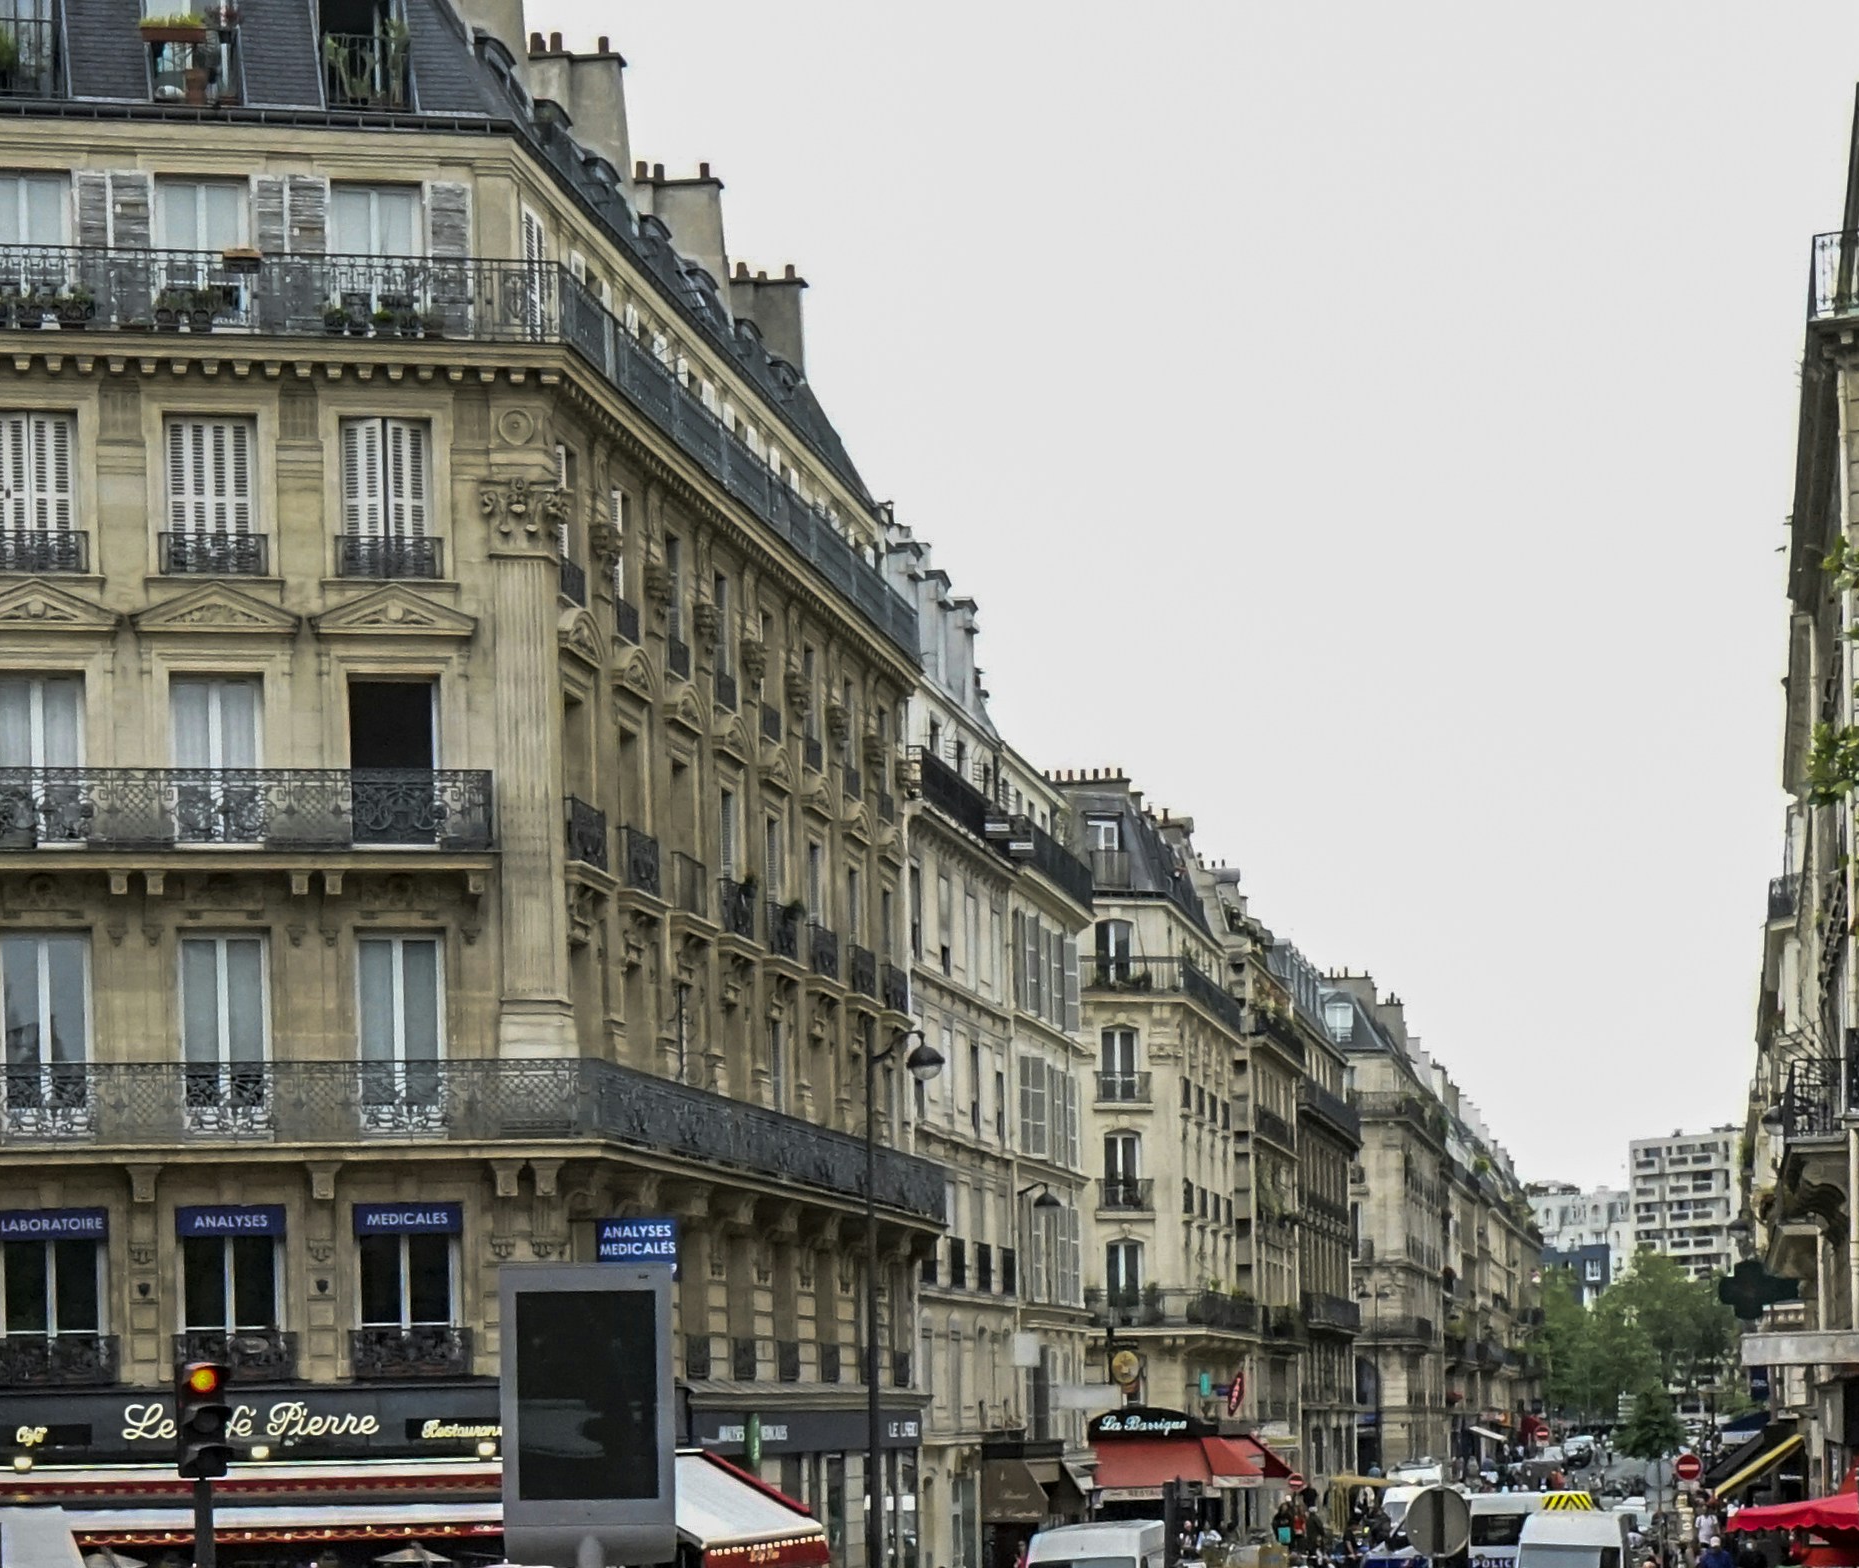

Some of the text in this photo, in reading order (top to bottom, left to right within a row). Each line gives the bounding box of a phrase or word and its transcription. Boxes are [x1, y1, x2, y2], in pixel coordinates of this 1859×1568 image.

[1, 1218, 104, 1232] LABORATOIRE
[194, 1214, 268, 1228] ANALYSES
[366, 1212, 449, 1226] MEDICALES
[603, 1225, 672, 1238] ANALYSES
[122, 1403, 178, 1439] Le
[266, 1402, 380, 1436] Pierre
[1099, 1415, 1187, 1436] La Barrique
[1471, 1559, 1513, 1568] POLIC
